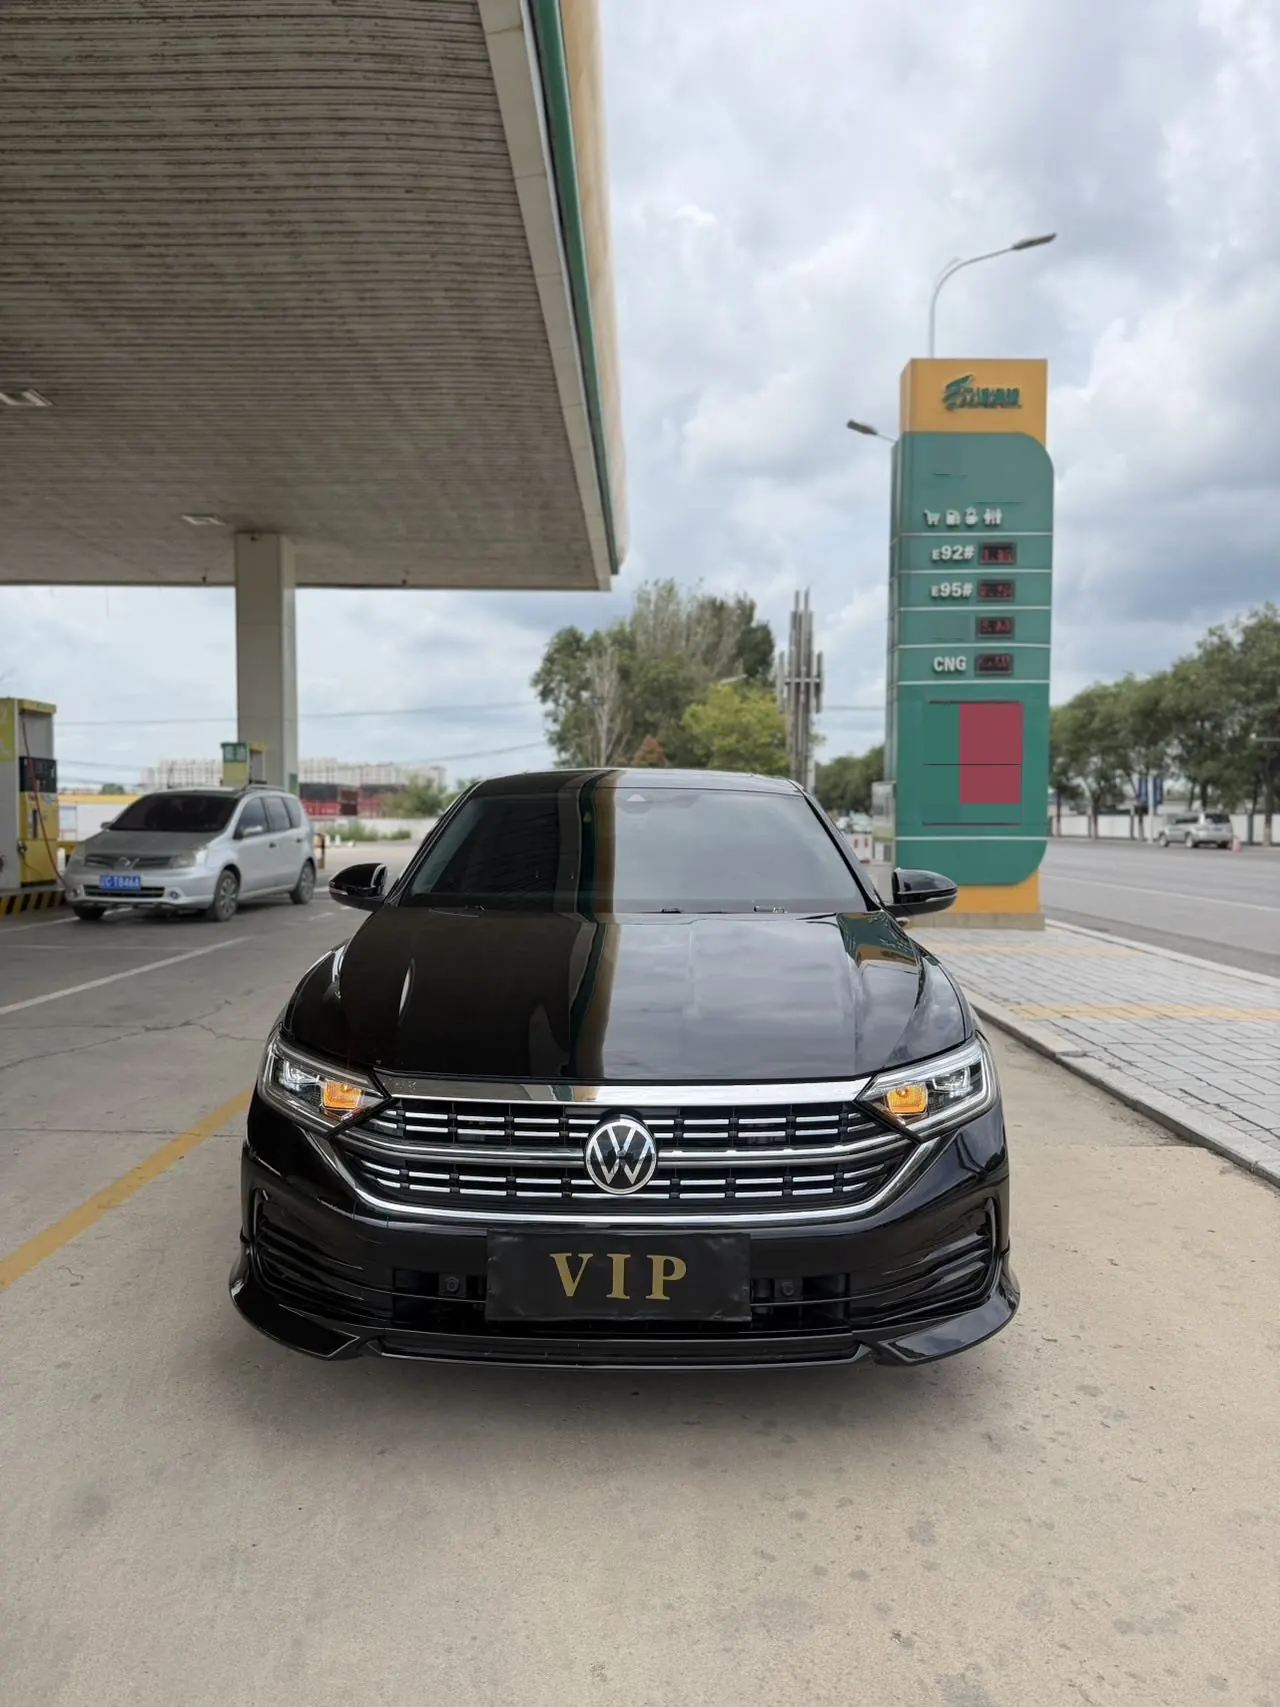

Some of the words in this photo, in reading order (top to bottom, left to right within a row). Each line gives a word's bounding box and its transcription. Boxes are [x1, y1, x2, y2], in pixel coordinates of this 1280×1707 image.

[931, 545, 975, 561] E92#
[930, 582, 973, 598] E95#
[933, 656, 967, 672] CNG
[549, 1252, 688, 1301] VIP
